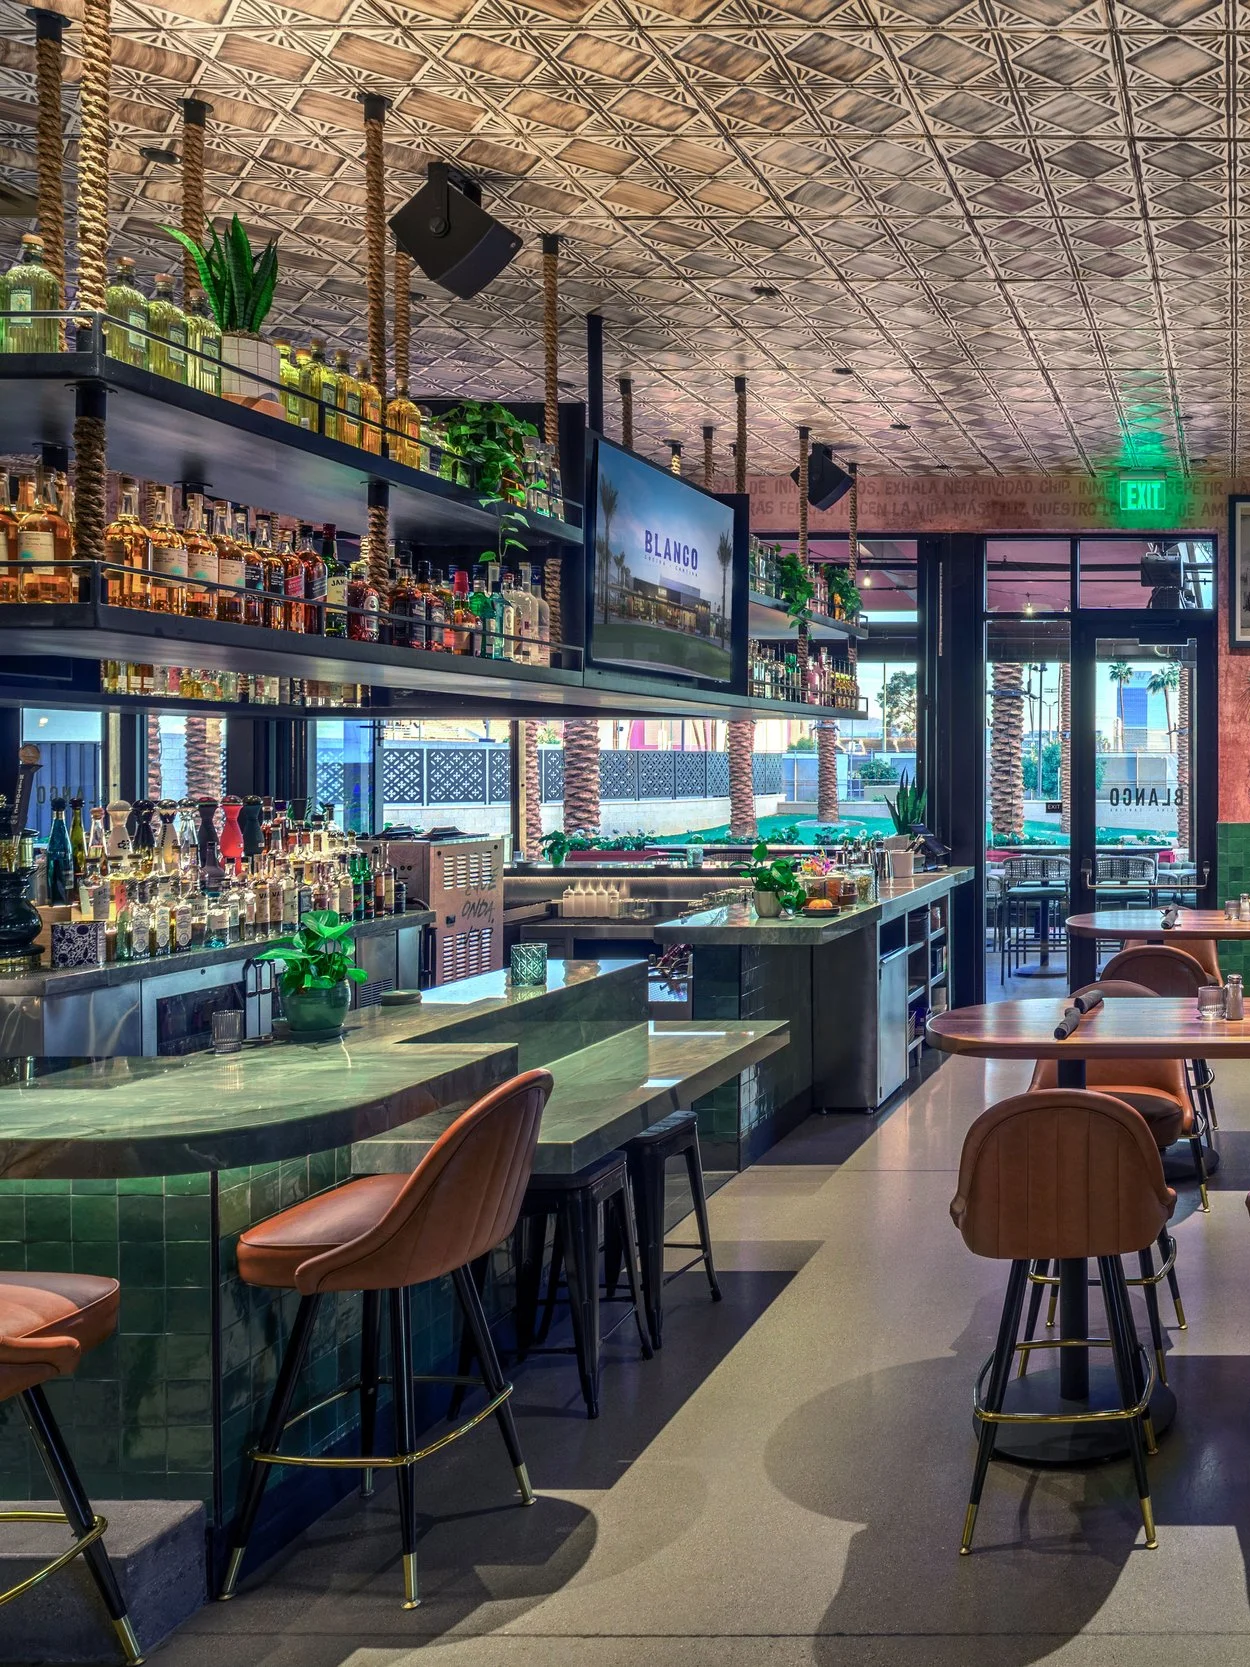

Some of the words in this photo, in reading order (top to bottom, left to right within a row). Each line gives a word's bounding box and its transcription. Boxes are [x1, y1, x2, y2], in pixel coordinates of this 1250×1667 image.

[885, 480, 938, 495] EXHALA
[1127, 481, 1161, 509] EXIT
[893, 502, 911, 517] LA
[1032, 502, 1097, 517] NUESTRO
[645, 529, 698, 571] BLANCO
